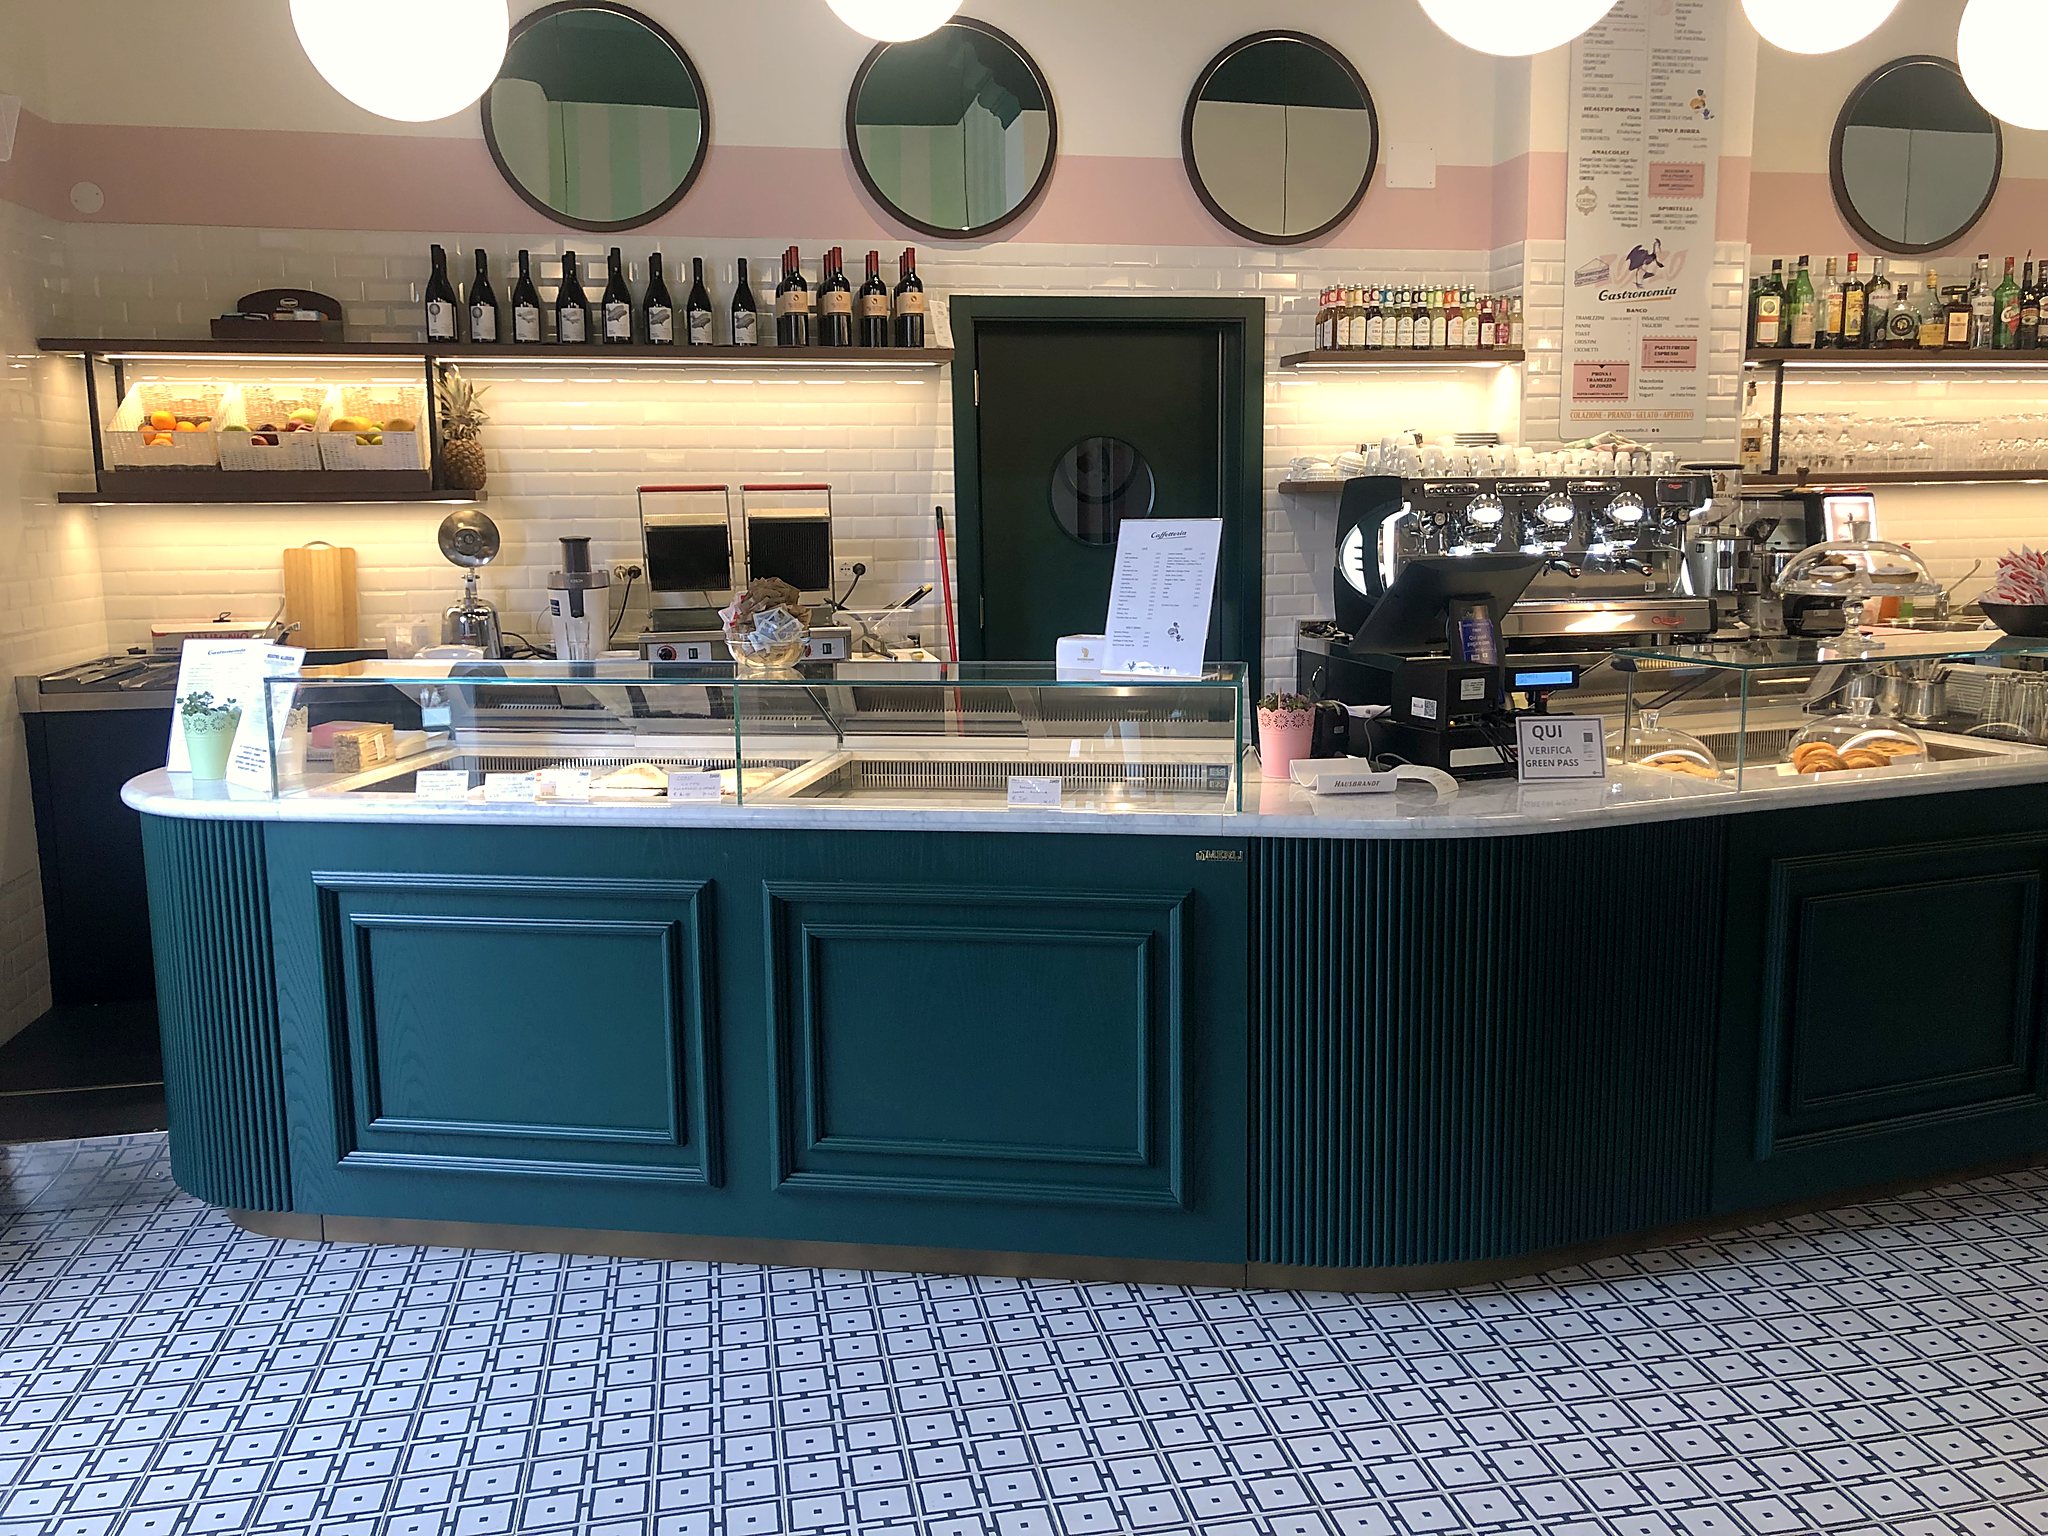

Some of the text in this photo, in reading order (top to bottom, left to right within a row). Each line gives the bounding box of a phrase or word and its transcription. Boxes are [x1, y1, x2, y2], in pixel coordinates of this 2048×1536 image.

[1598, 286, 1677, 302] Gastronomia
[1151, 530, 1187, 540] Caffetteria
[1532, 724, 1562, 741] QUI
[1528, 746, 1572, 755] VERIFICA
[1525, 758, 1579, 768] GREEN PASS
